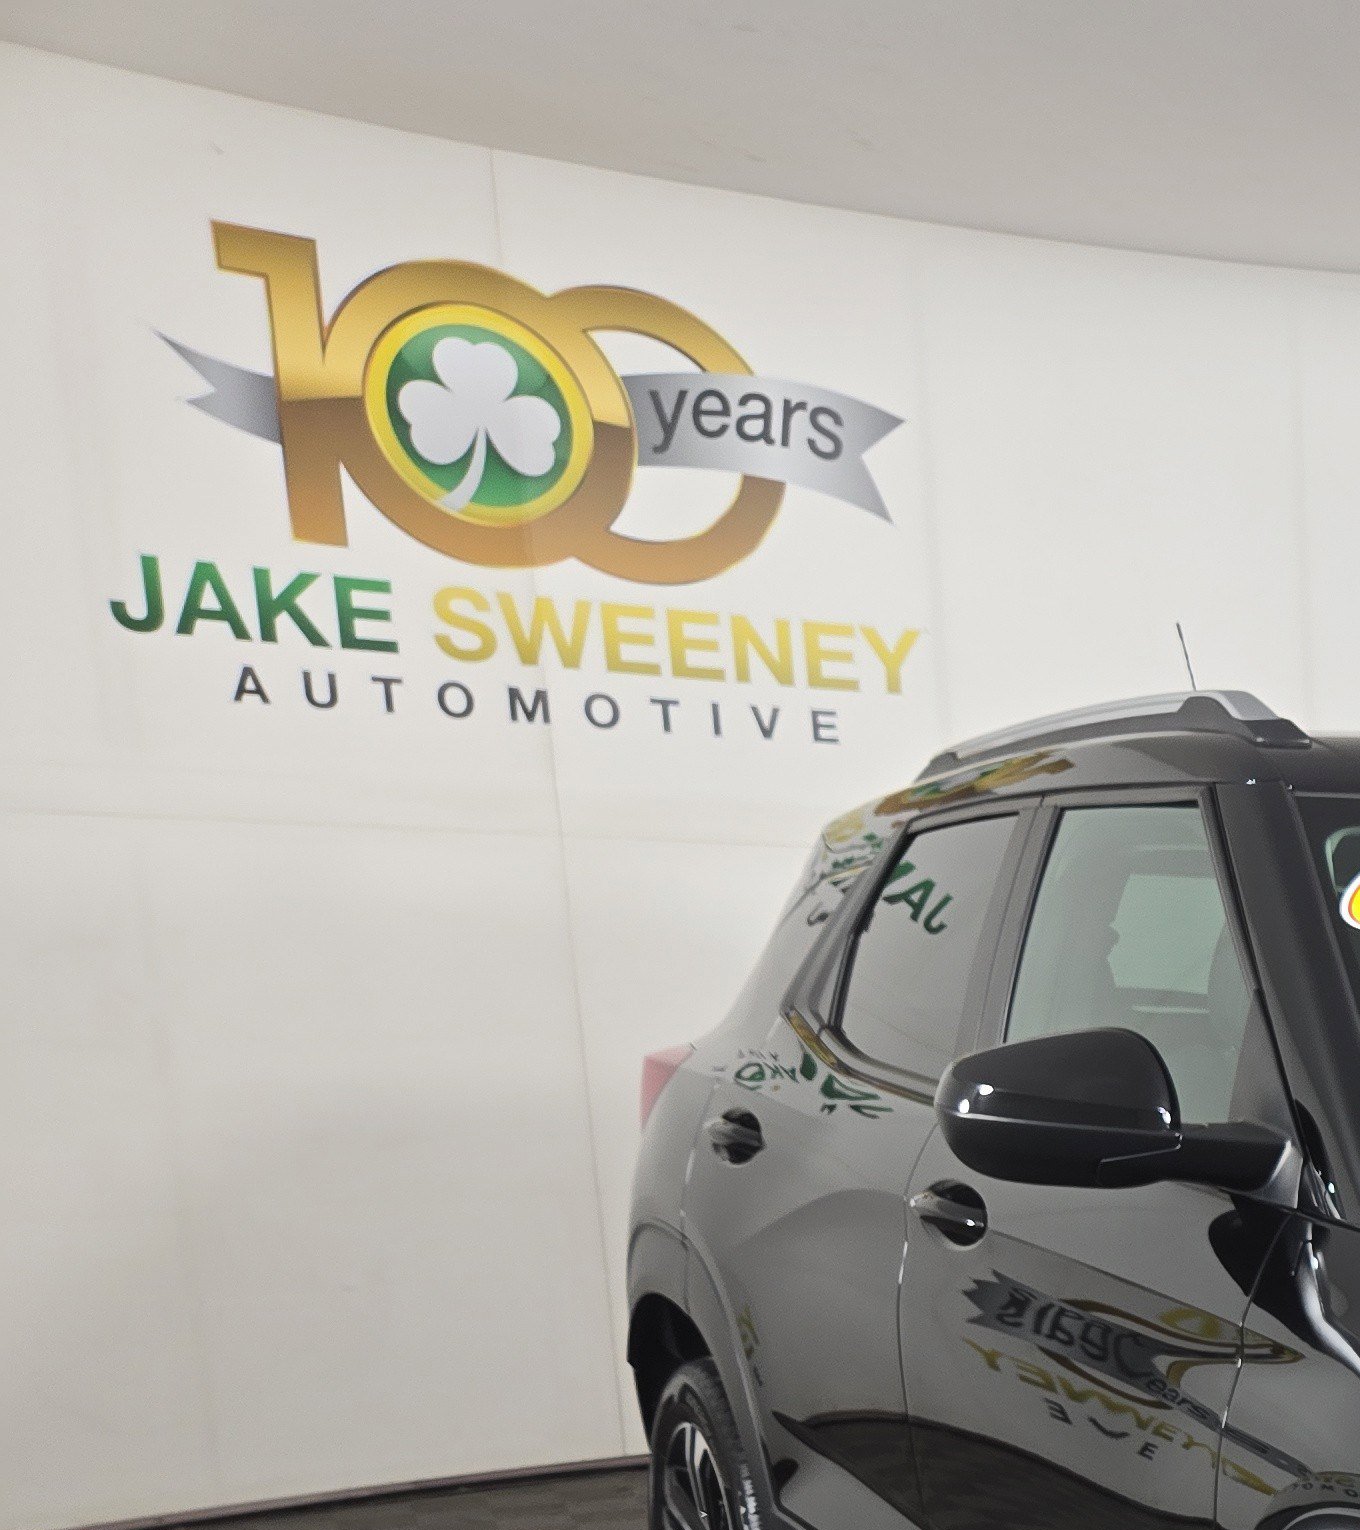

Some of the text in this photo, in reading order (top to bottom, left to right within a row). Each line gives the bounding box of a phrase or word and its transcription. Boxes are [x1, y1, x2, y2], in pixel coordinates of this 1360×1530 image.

[210, 220, 844, 586] 100 years
[108, 555, 920, 695] JAKE SWEENEY
[233, 665, 841, 745] AUTOMOTIVE
